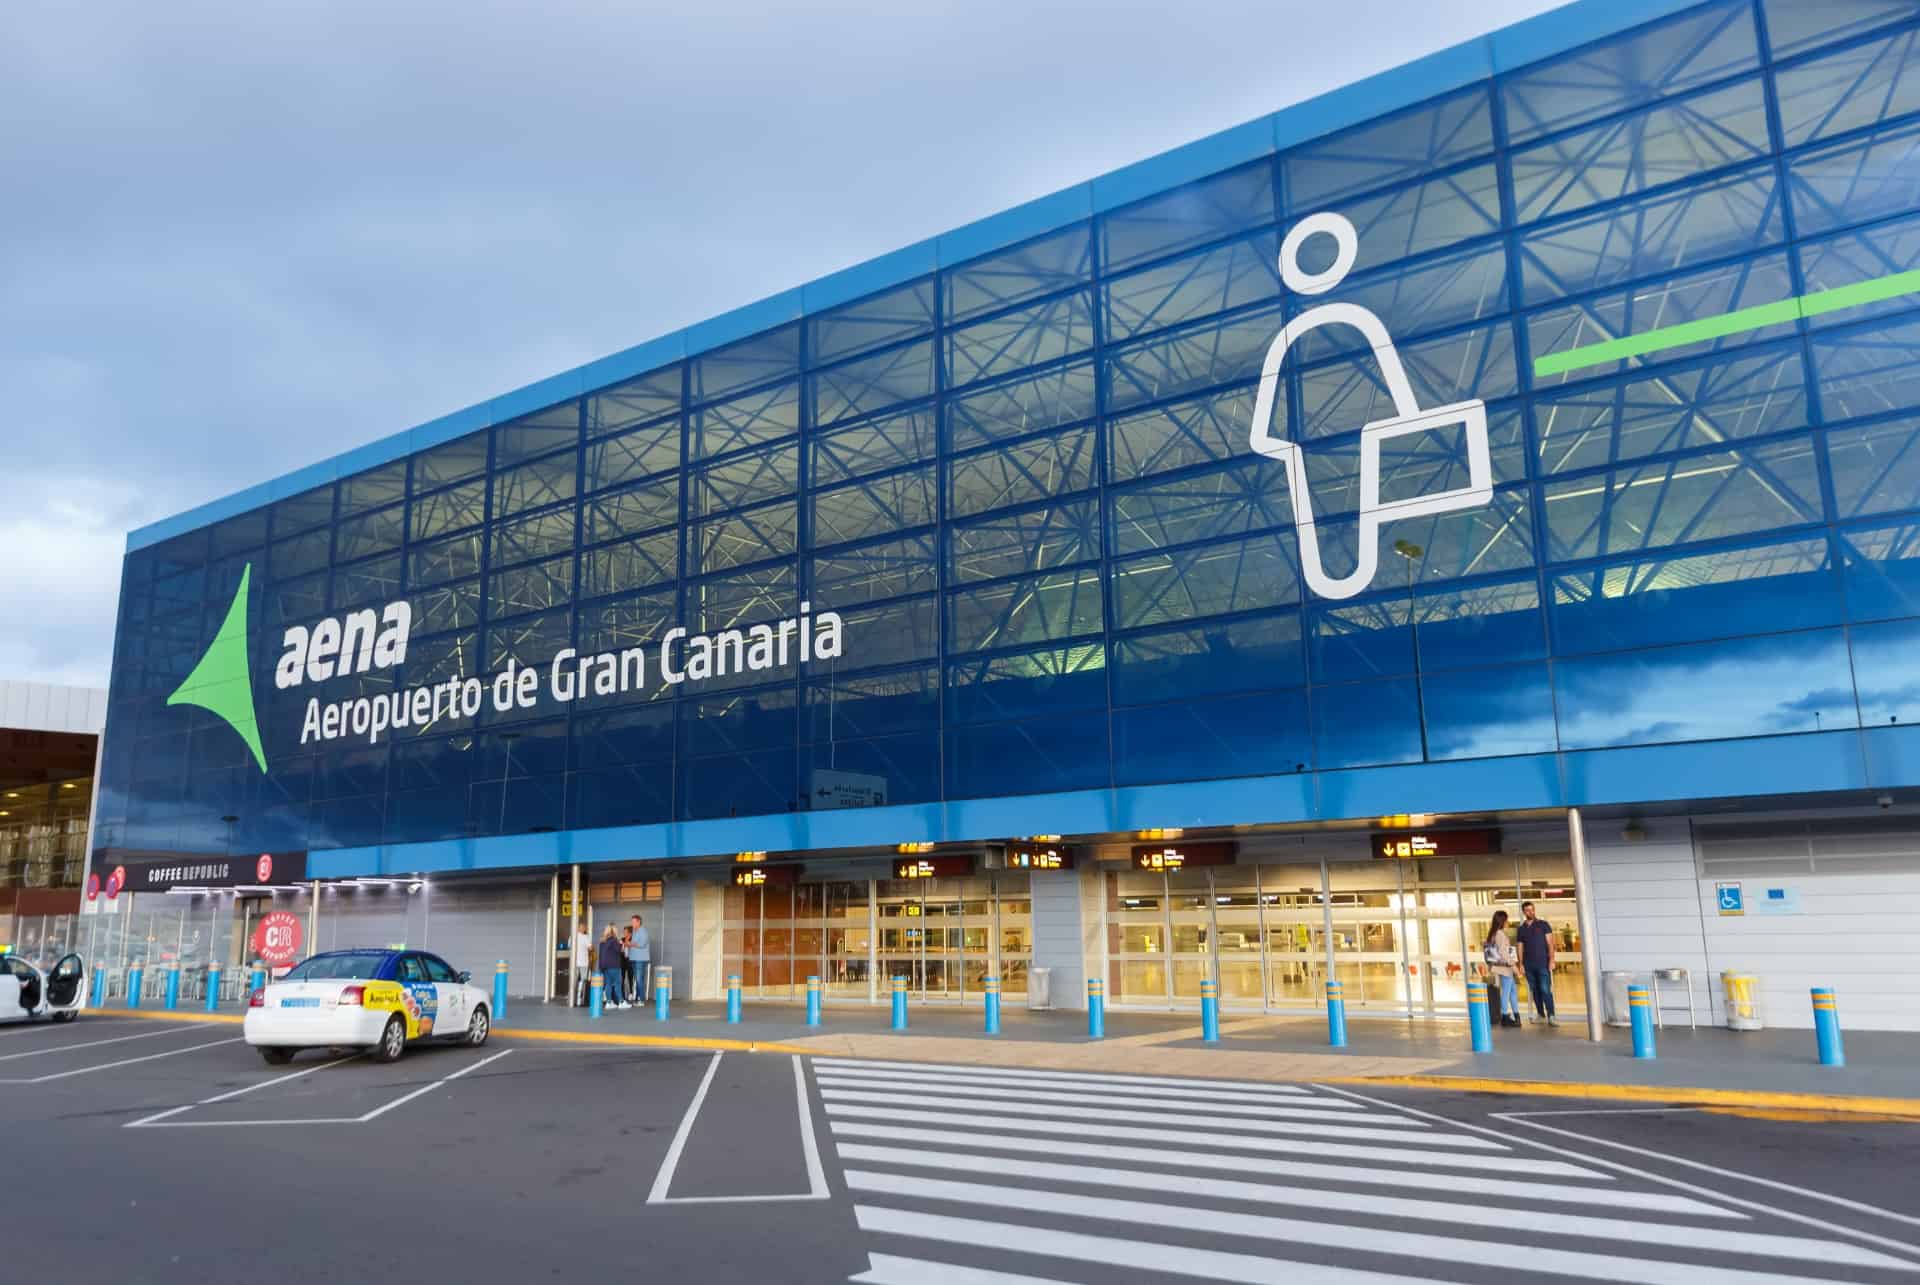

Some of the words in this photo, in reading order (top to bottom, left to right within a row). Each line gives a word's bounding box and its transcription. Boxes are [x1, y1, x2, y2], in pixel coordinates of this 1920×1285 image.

[275, 601, 411, 689] aena
[301, 674, 481, 744] Aeropuerto
[493, 659, 538, 711] de
[552, 648, 645, 701] Gran
[661, 601, 842, 684] Canaria
